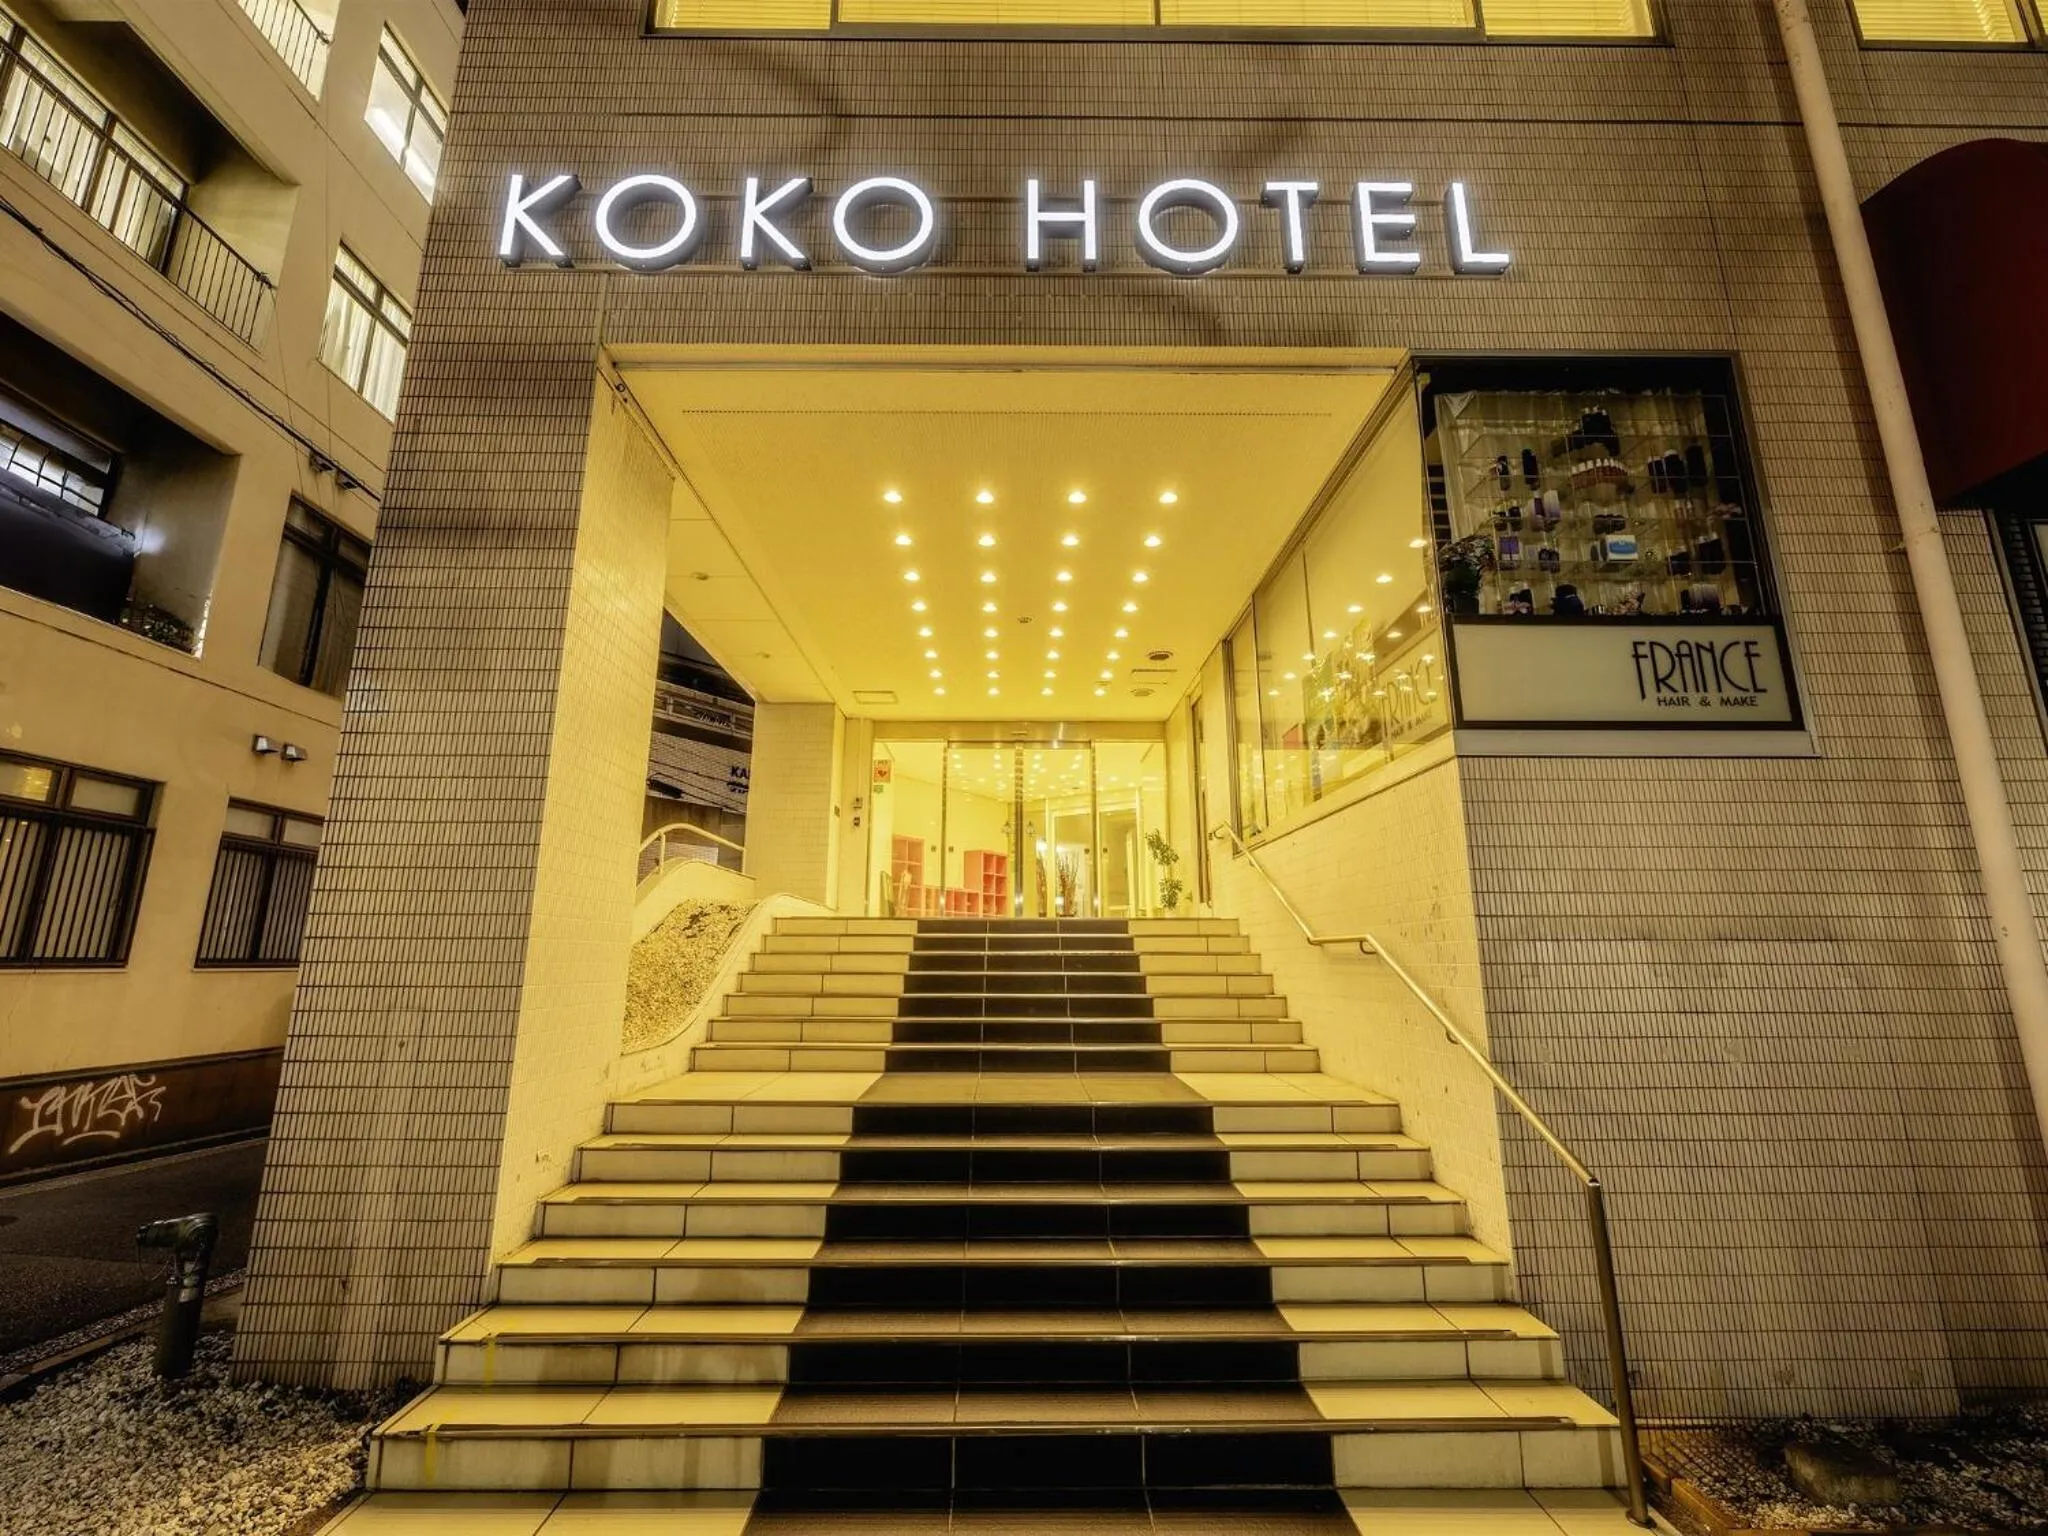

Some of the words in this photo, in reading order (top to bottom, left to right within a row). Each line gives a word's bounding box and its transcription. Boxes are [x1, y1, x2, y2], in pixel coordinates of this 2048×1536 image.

[499, 173, 936, 270] KOKO
[1025, 178, 1511, 273] HOTEL
[1632, 639, 1768, 700] FRANCE
[1657, 695, 1691, 707] HAIR
[1698, 695, 1712, 707] &
[1719, 695, 1760, 707] MAKE
